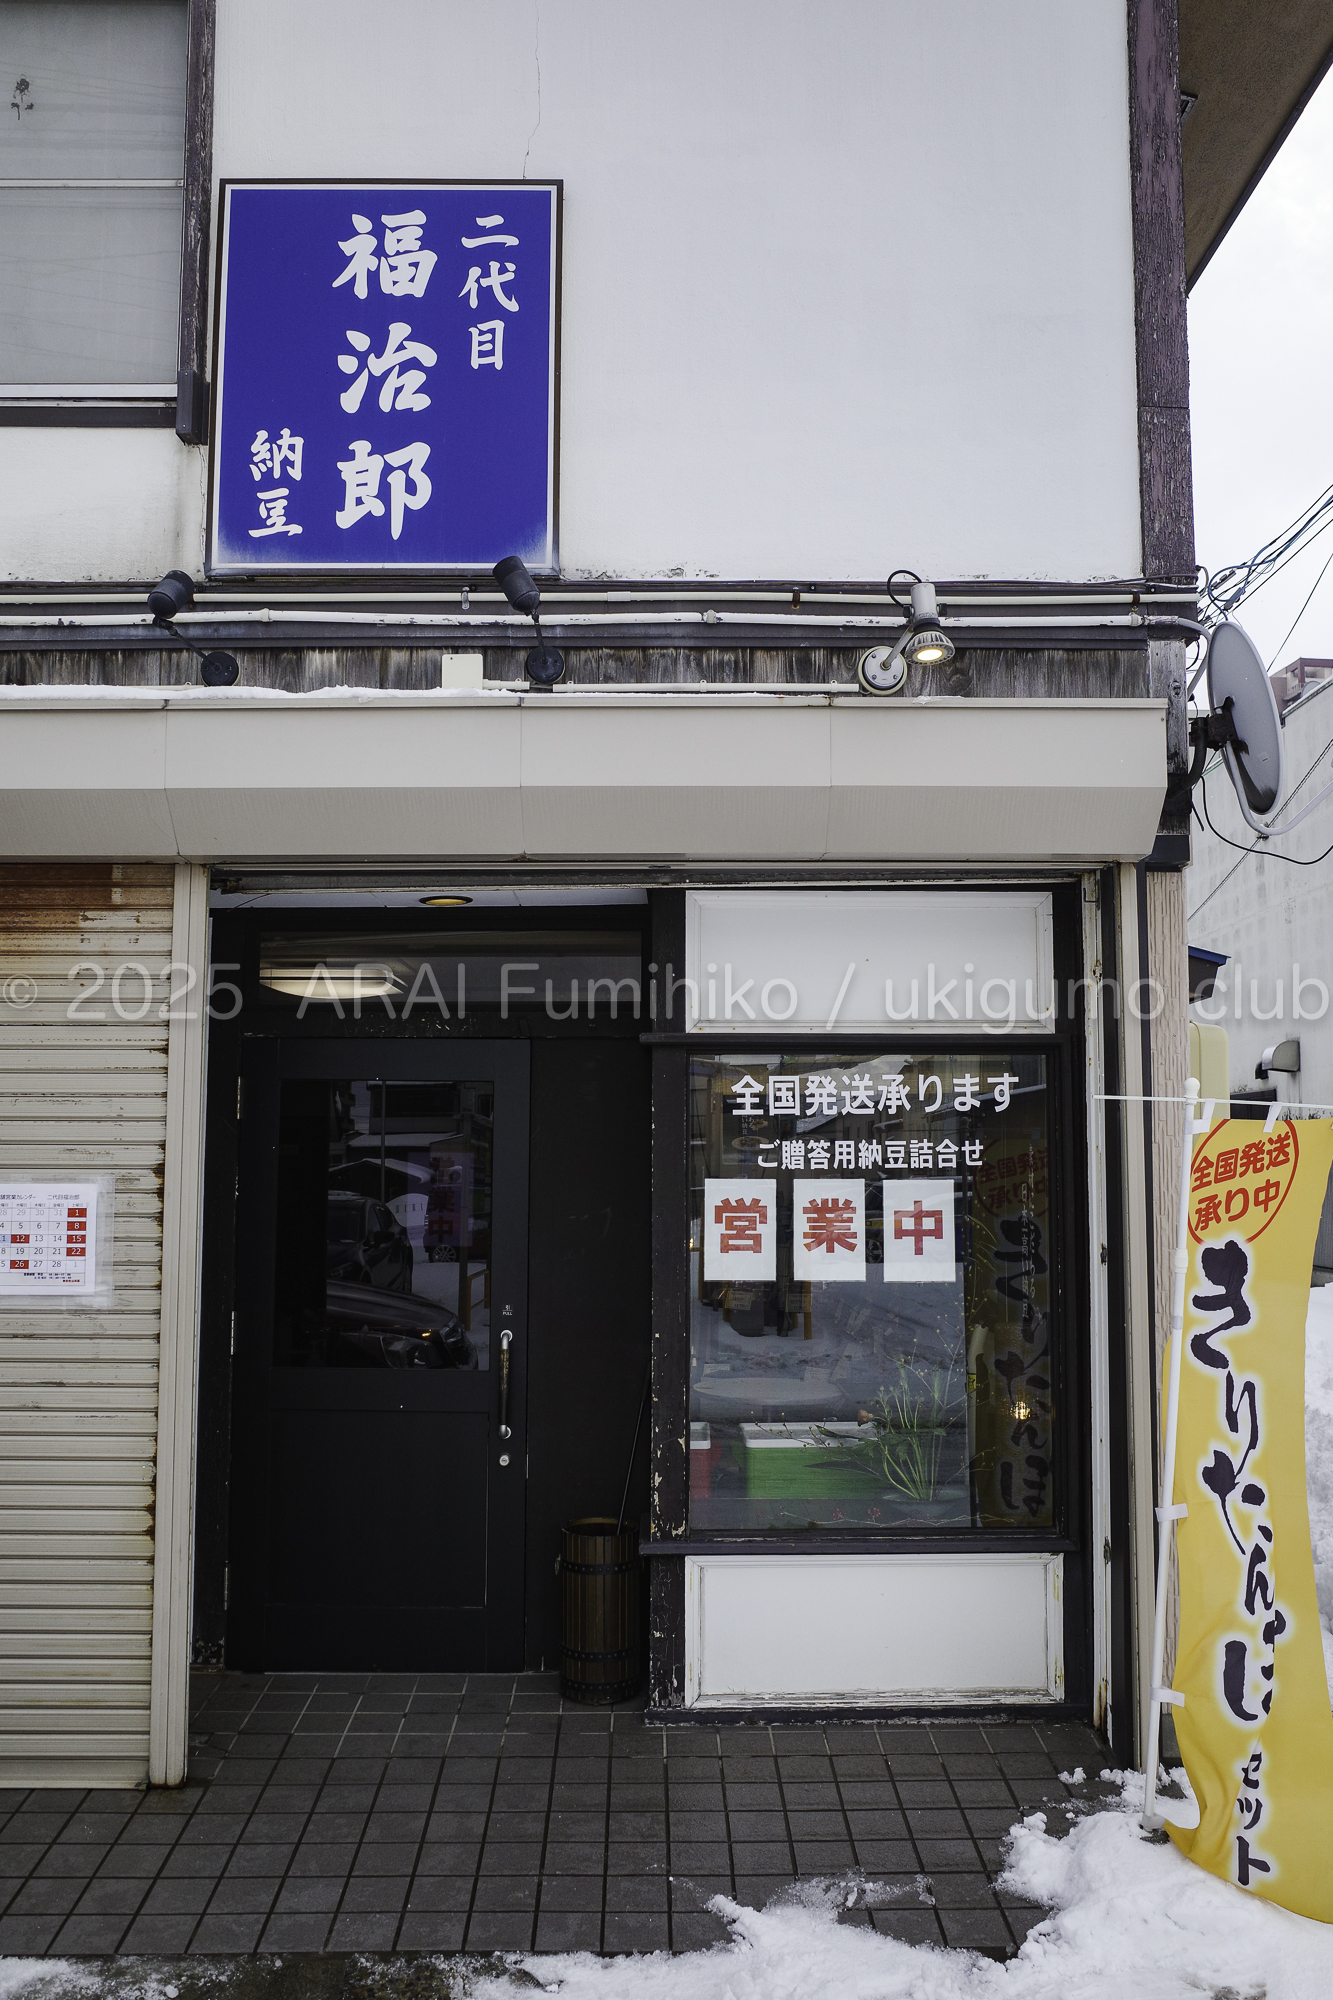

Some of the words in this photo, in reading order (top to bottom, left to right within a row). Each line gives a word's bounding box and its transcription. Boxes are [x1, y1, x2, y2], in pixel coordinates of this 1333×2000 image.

[458, 214, 520, 371] 二代目
[331, 209, 438, 540] 福治郎
[248, 427, 305, 538] 納豆
[730, 1072, 1019, 1117] 全国発送承ります
[756, 1138, 984, 1171] ご贈答用納豆詰合せ
[1191, 1133, 1292, 1193] 全国発送
[713, 1196, 945, 1256] 営業中
[1194, 1178, 1281, 1232] 承り中
[1236, 1751, 1272, 1887] セット
